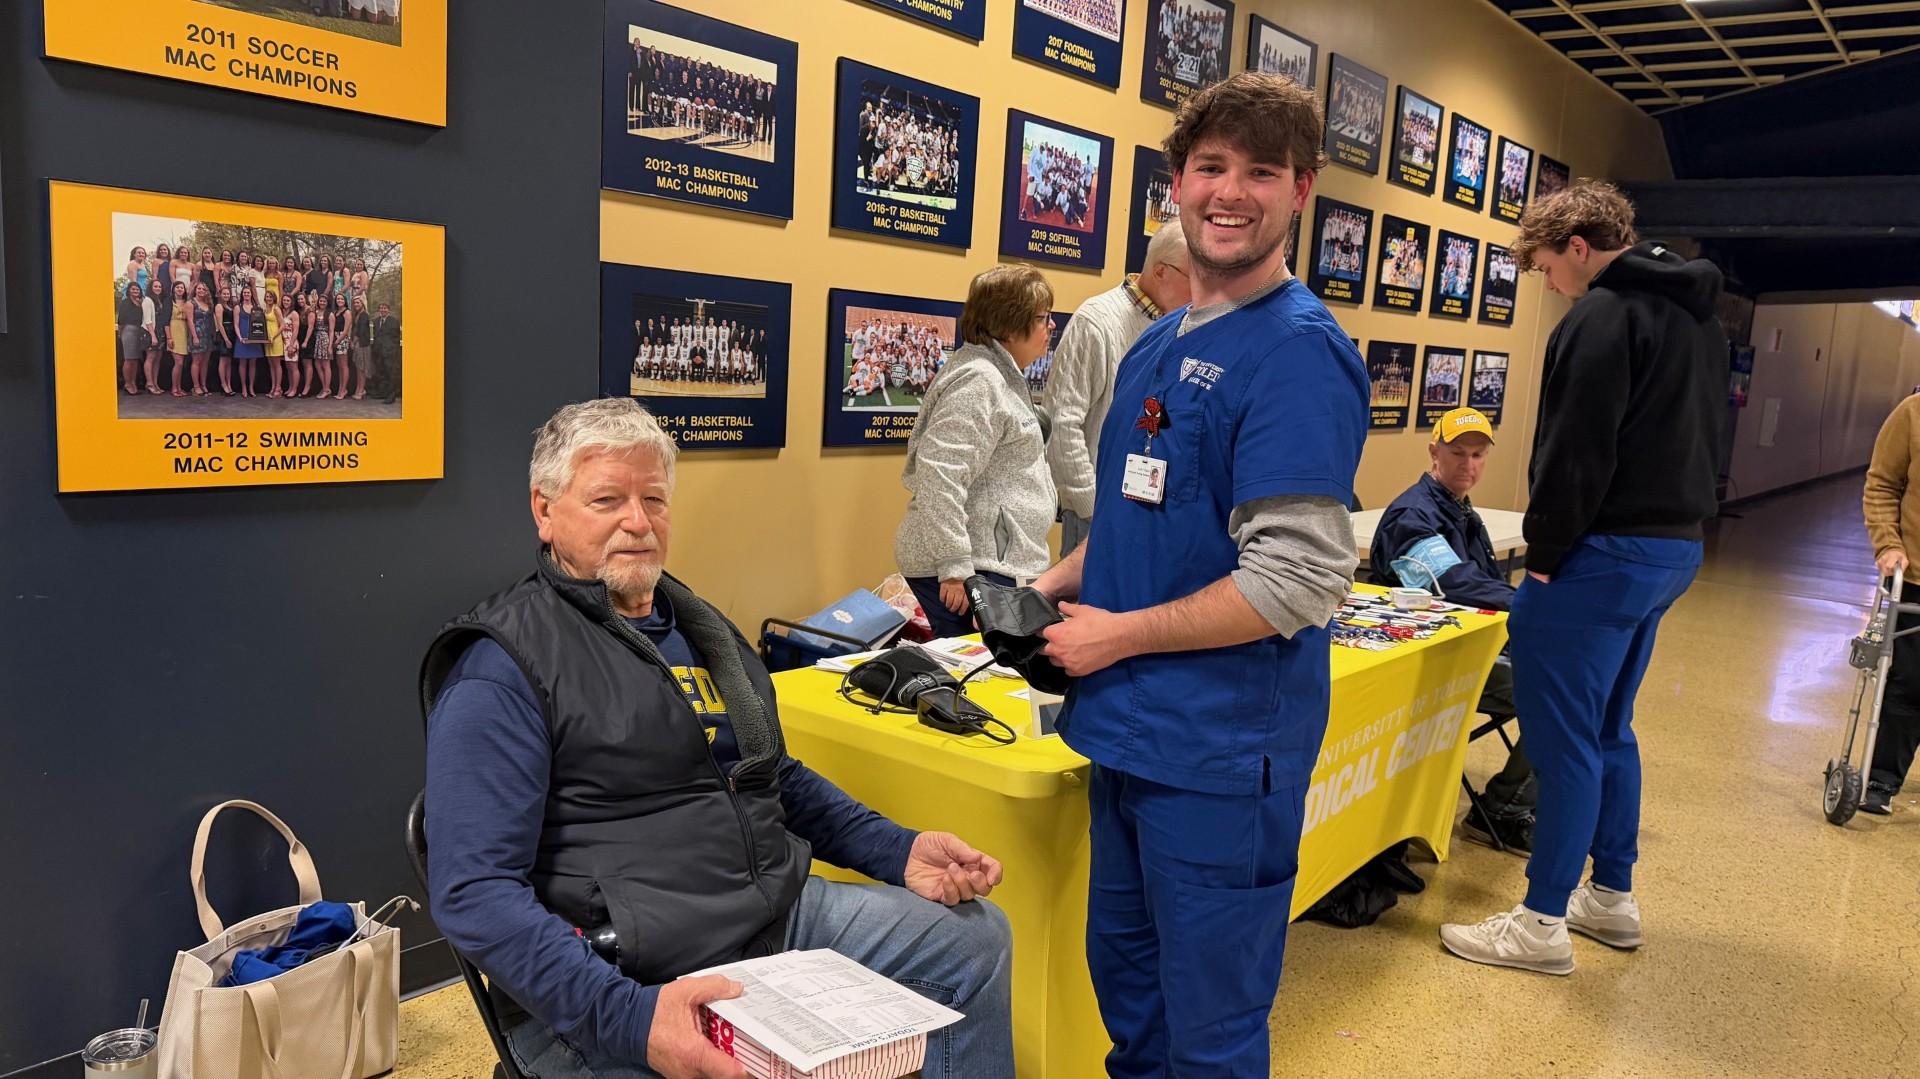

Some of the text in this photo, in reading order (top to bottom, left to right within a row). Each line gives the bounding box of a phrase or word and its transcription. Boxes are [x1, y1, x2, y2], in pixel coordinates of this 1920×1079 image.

[186, 23, 339, 71] 2011 SOCCER
[1048, 34, 1094, 61] 2017 FOOTBALL
[1044, 46, 1096, 73] MAC CHAMPIONS
[165, 45, 357, 99] MAC CHAMPIONS
[1165, 90, 1176, 101] MAC
[1172, 81, 1190, 95] CROSS
[644, 156, 759, 189] 2012-13 BASKETBALL
[656, 175, 749, 203] MAC CHAMPIONS
[866, 201, 947, 225] 2016-17 BASKETBALL
[873, 216, 939, 237] MAC CHAMPIONS
[1031, 229, 1080, 246] 2019 SOFTBALL
[1028, 241, 1081, 259] MAC CHAMPIONS
[690, 415, 754, 427] BASKETBALL
[872, 415, 890, 426] 2017
[163, 431, 368, 450] 2011-12 SWIMMING
[682, 430, 743, 442] CHAMPIONS
[864, 428, 882, 439] MAC
[174, 453, 359, 474] MAC CHAMPIONS
[1315, 704, 1407, 772] NIVERSITY
[1409, 695, 1426, 718] OF
[879, 1026, 918, 1041] TODAY'S
[851, 1038, 878, 1049] GAME
